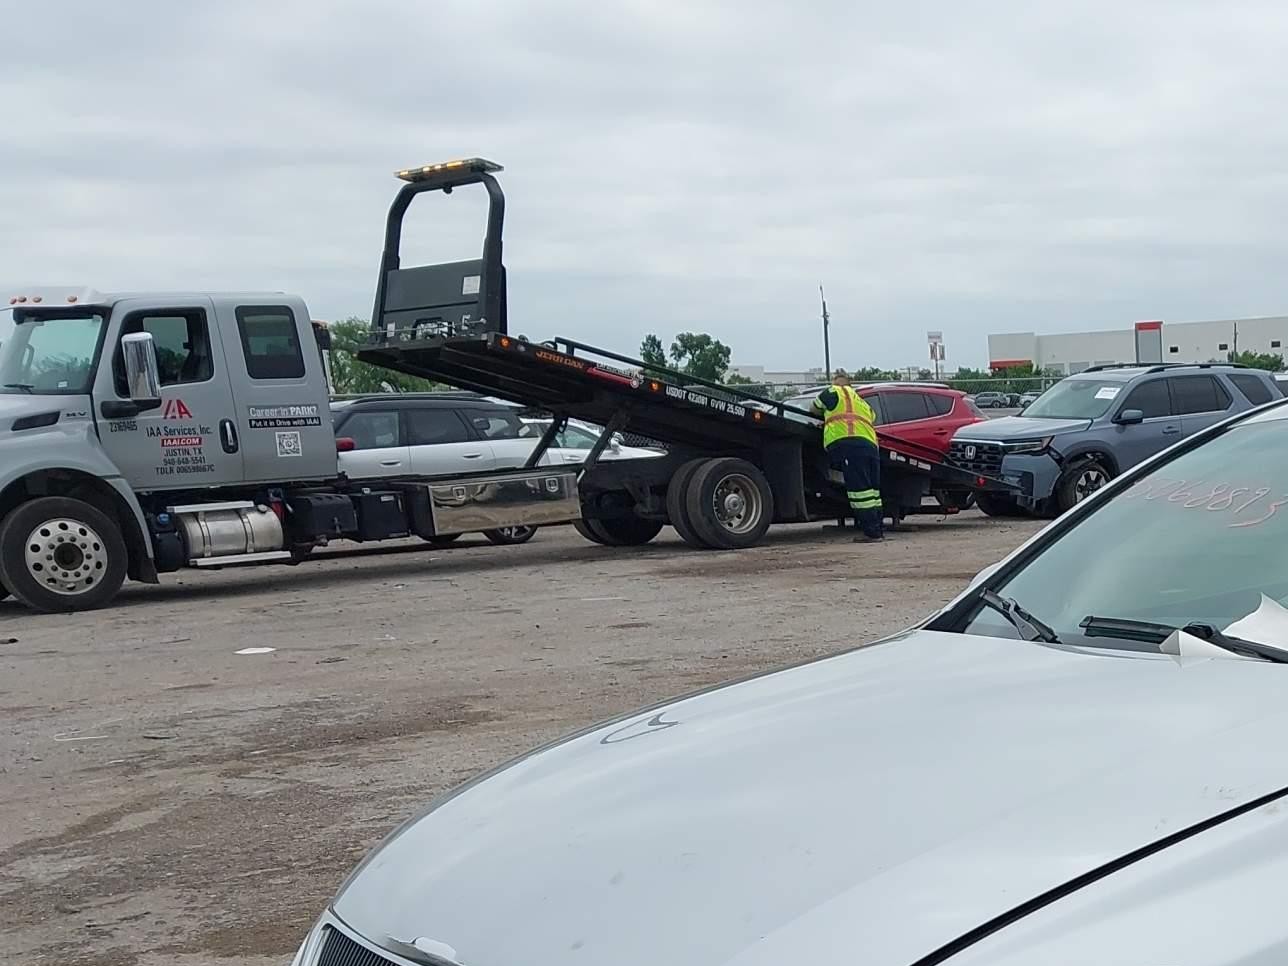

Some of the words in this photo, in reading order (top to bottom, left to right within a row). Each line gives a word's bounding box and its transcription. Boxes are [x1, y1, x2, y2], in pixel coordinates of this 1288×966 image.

[665, 385, 687, 399] USDOT
[710, 399, 726, 411] GVW
[146, 426, 162, 438] IAA
[200, 423, 213, 435] Inc.
[193, 447, 203, 456] TX
